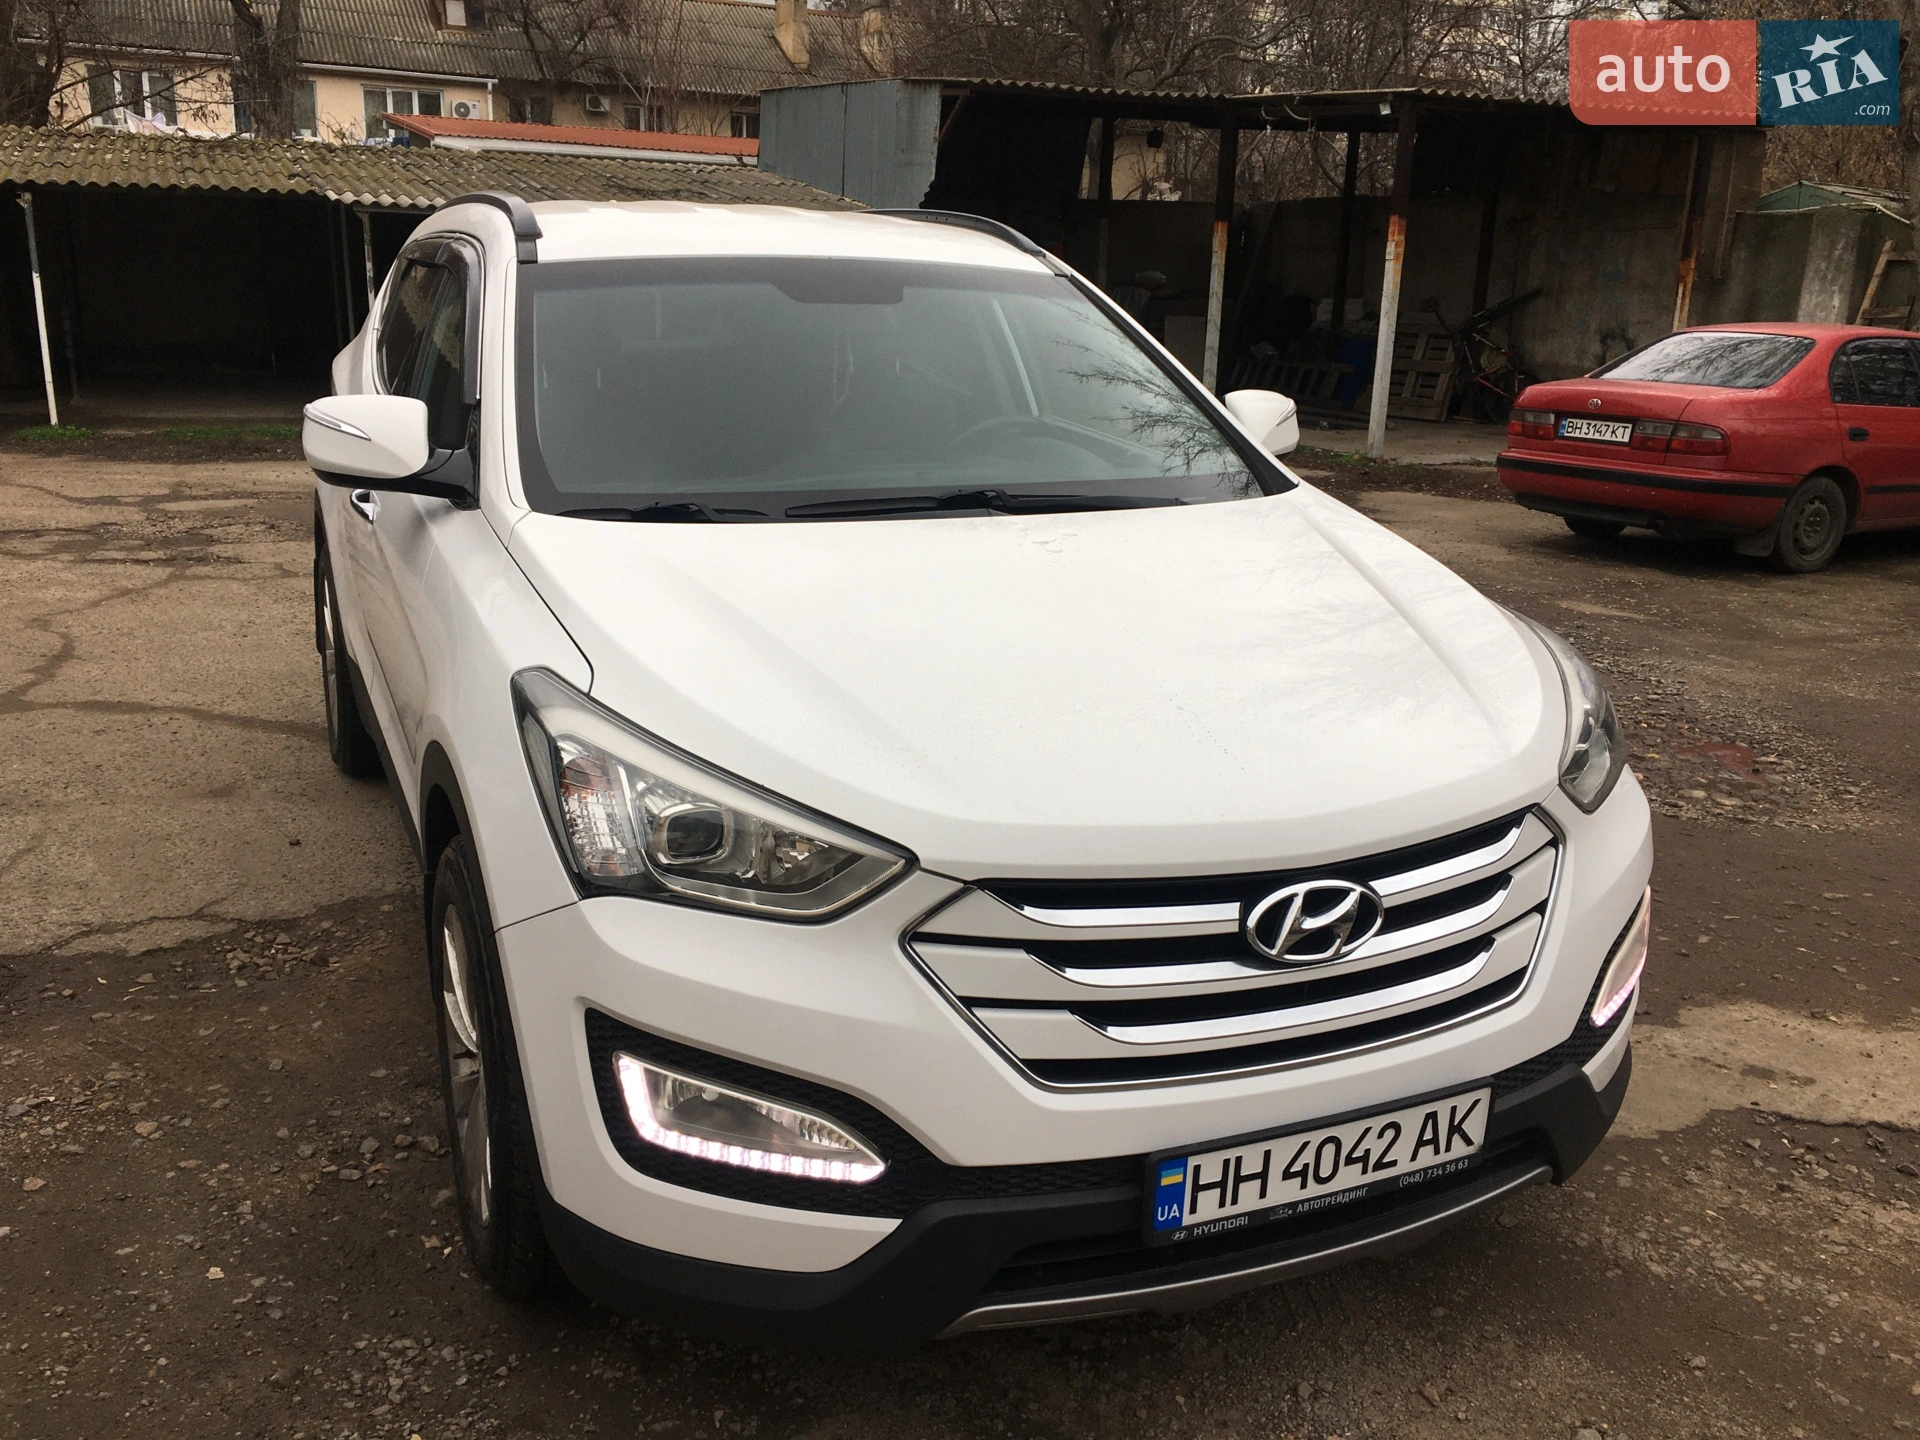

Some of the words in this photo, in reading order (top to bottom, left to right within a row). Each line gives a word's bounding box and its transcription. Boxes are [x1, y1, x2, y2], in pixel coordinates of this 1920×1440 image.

[1188, 1148, 1272, 1216] HH
[1281, 1120, 1403, 1191] 4042
[1409, 1097, 1482, 1163] AK
[1399, 1170, 1424, 1188] (048)
[1427, 1166, 1443, 1179] 734
[1444, 1162, 1456, 1174] 36
[1457, 1159, 1469, 1170] 63
[1157, 1203, 1180, 1221] UA
[1296, 1187, 1369, 1214] АВТОТРЕЙДИНГ
[1193, 1215, 1249, 1237] HYUNDAI
